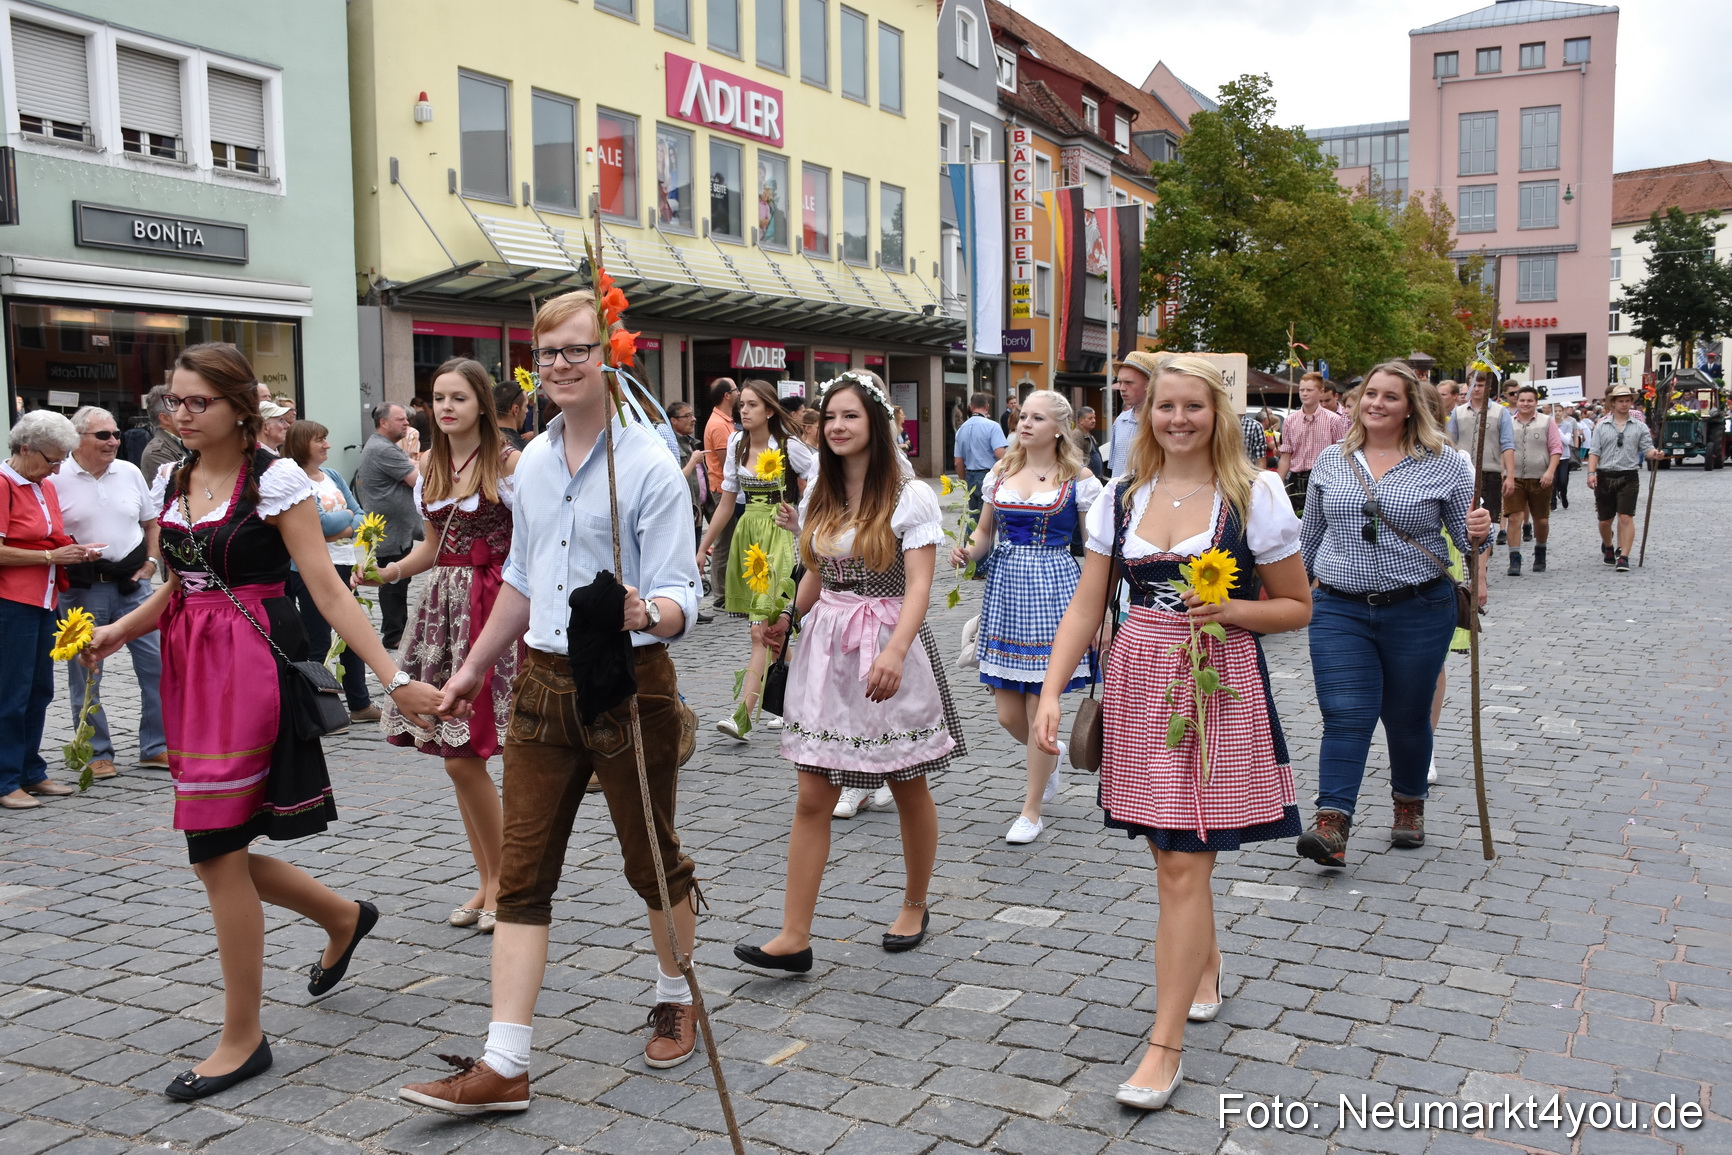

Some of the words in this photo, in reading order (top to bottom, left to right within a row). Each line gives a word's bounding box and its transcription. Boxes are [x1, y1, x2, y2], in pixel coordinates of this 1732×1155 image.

[679, 62, 781, 140] ADLER
[598, 145, 622, 167] ALE
[1013, 130, 1027, 278] BÄCKEREI
[134, 220, 205, 249] BONITA
[1012, 285, 1030, 297] café
[1497, 315, 1558, 329] arkasse
[1002, 334, 1030, 348] iberty
[738, 340, 787, 369] ADLER
[262, 372, 288, 384] BONITA
